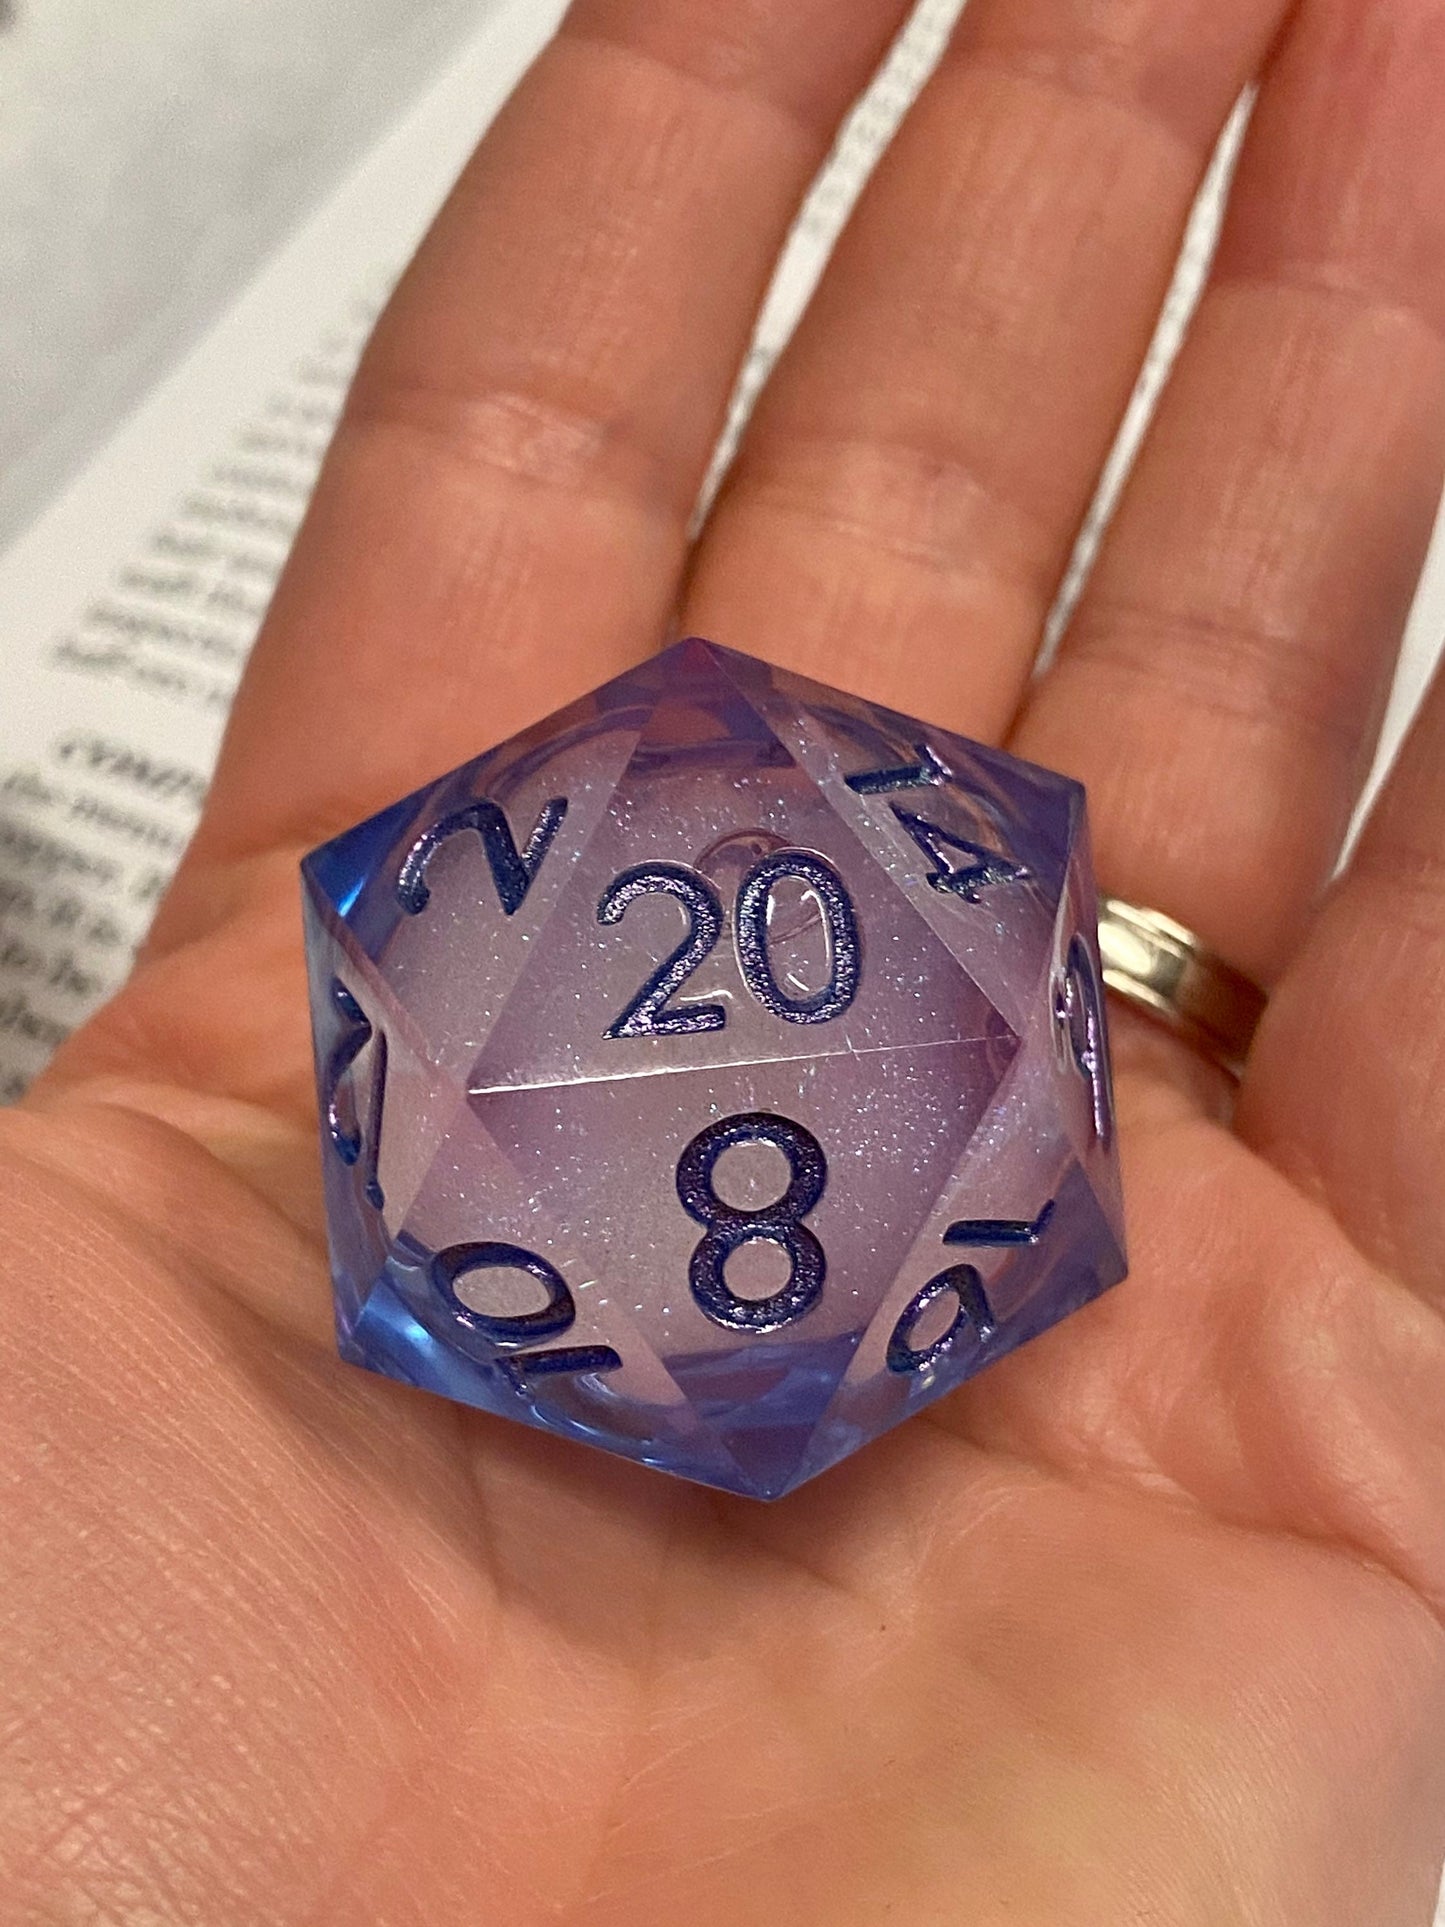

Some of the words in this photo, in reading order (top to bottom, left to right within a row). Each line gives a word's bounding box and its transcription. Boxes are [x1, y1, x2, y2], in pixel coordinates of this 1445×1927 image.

[398, 797, 568, 915] 2
[844, 743, 1033, 904] 14
[597, 847, 861, 1040] 20
[675, 1112, 828, 1335] 8
[430, 1241, 623, 1401] 10
